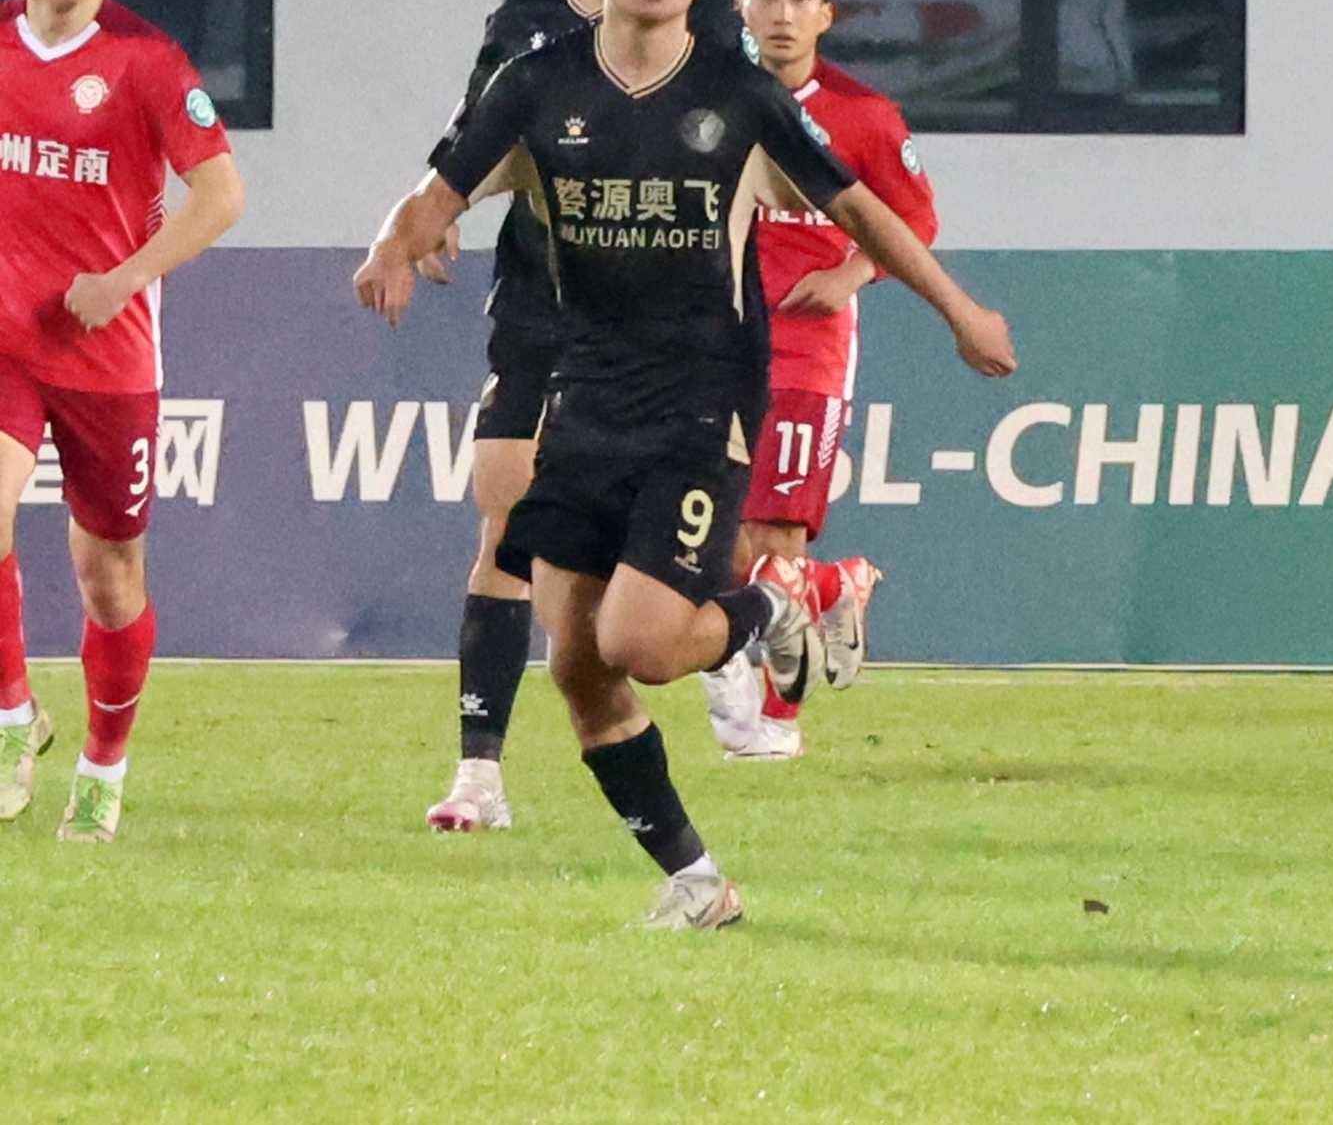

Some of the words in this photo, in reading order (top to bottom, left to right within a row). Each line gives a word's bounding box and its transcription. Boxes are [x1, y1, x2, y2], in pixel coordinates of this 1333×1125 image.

[651, 228, 720, 250] AOFEI
[129, 437, 150, 495] 3
[776, 421, 812, 477] 11
[677, 488, 714, 548] 9
